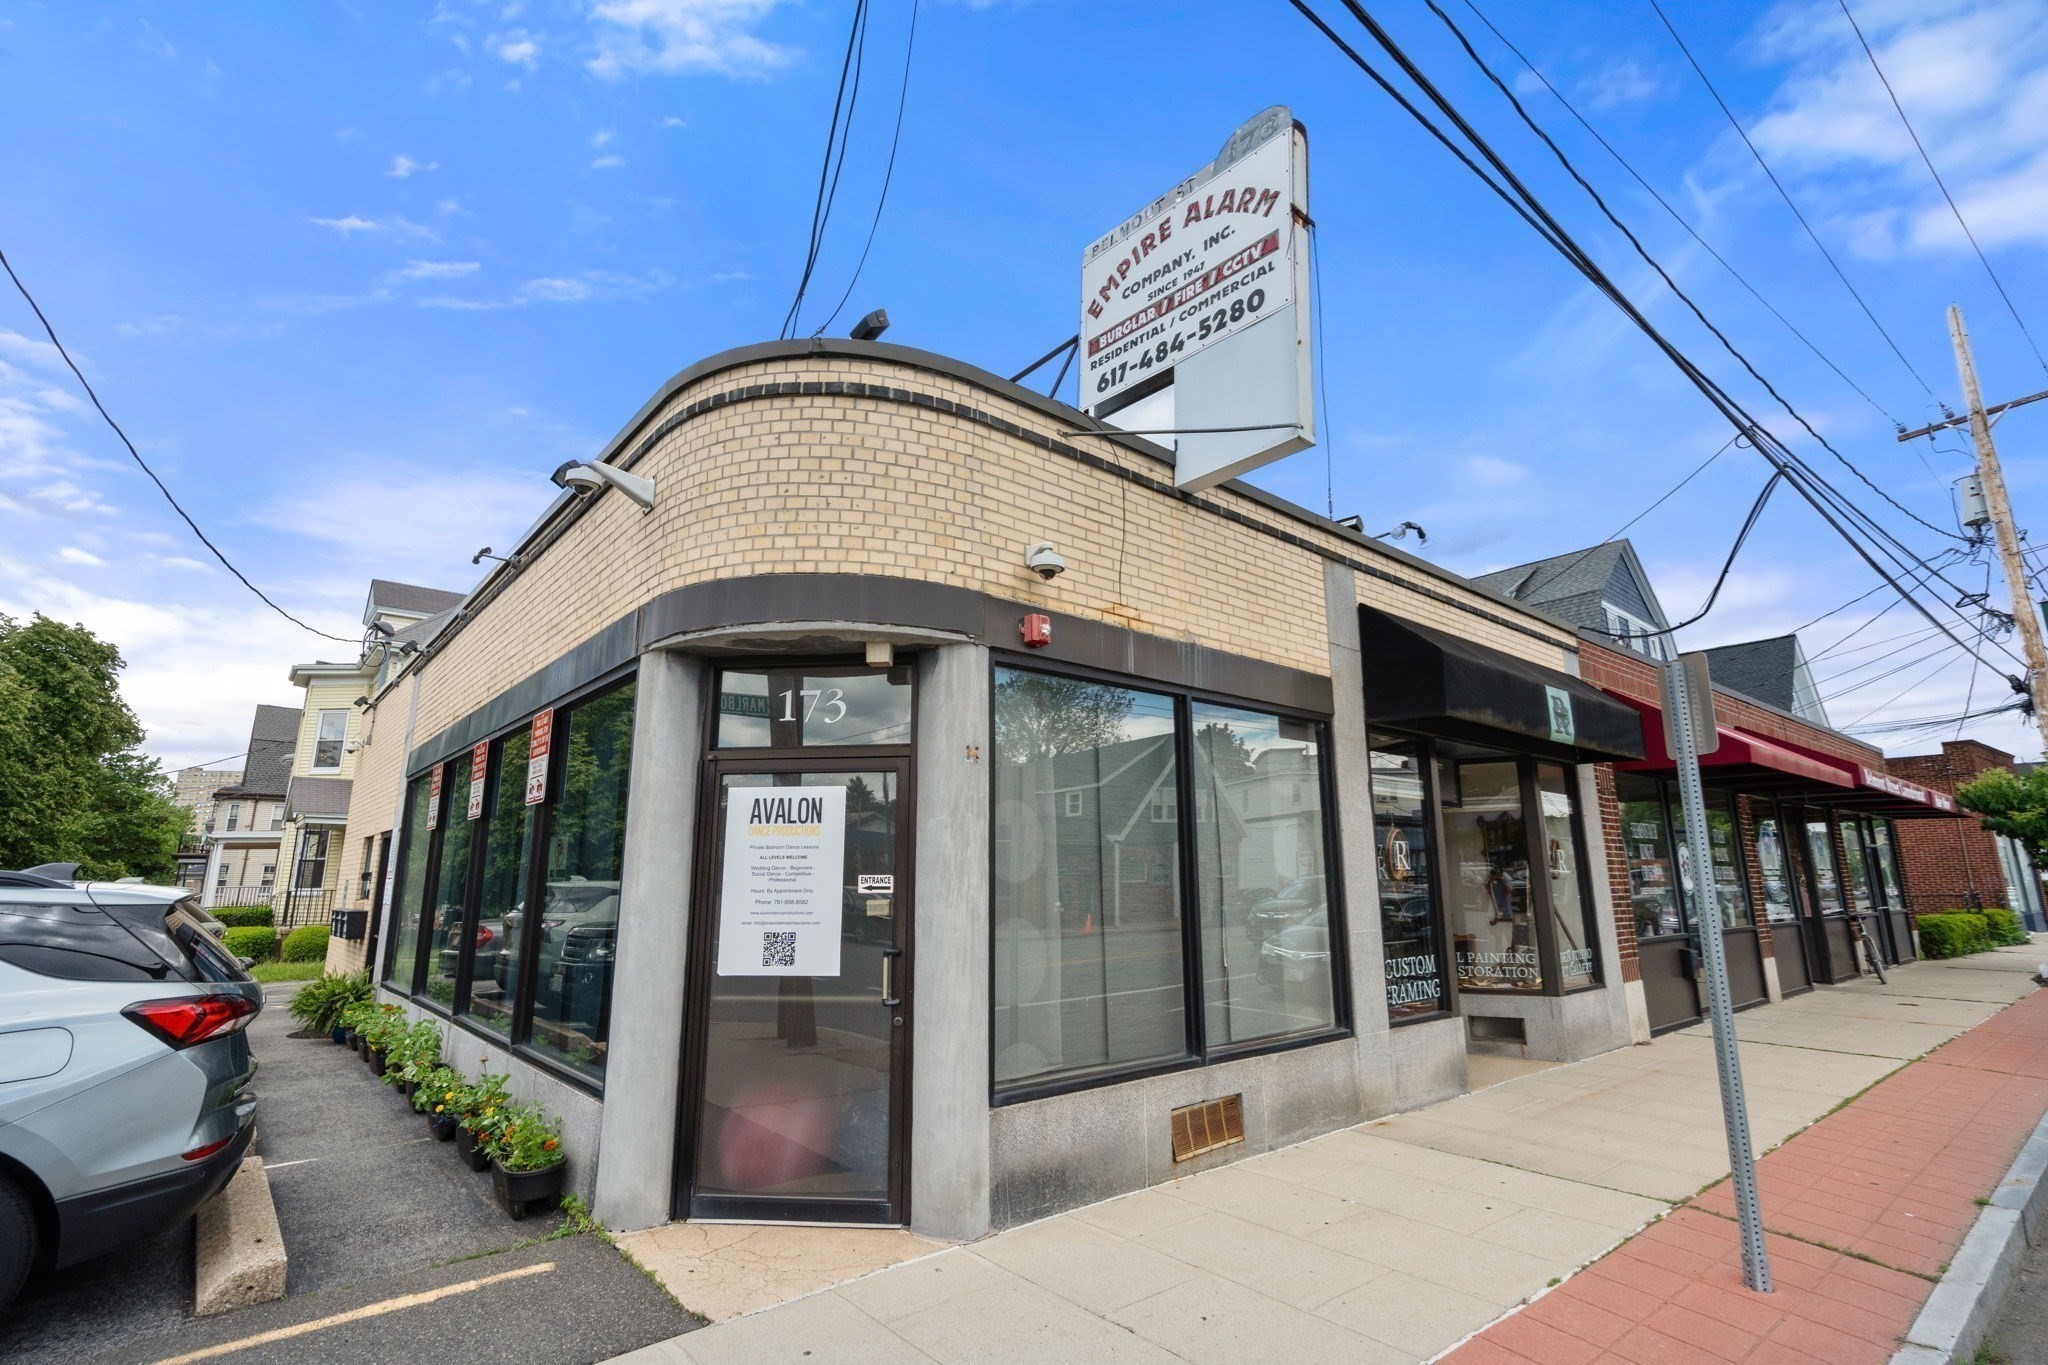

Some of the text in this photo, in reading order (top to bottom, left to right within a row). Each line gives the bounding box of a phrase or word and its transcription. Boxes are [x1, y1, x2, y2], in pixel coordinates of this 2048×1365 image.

[1088, 187, 1280, 319] EMPIRE ALARM
[1204, 225, 1236, 251] INC.
[1100, 306, 1156, 347] BURGLAR
[1173, 278, 1205, 306] FIRE
[1222, 241, 1267, 274] CCTV
[1147, 261, 1205, 301] SINCE 1947
[1090, 322, 1165, 371] RESIDENTIAL
[1179, 261, 1275, 322] COMMERCIAL
[1097, 288, 1265, 393] 617-484-5280
[779, 688, 847, 724] 173
[750, 797, 823, 824] AVALON
[749, 825, 821, 837] DANCE PRODUCTIONS
[1385, 954, 1436, 978] CUSTOM
[1457, 966, 1539, 978] STORATION
[1467, 952, 1536, 963] PAINTING
